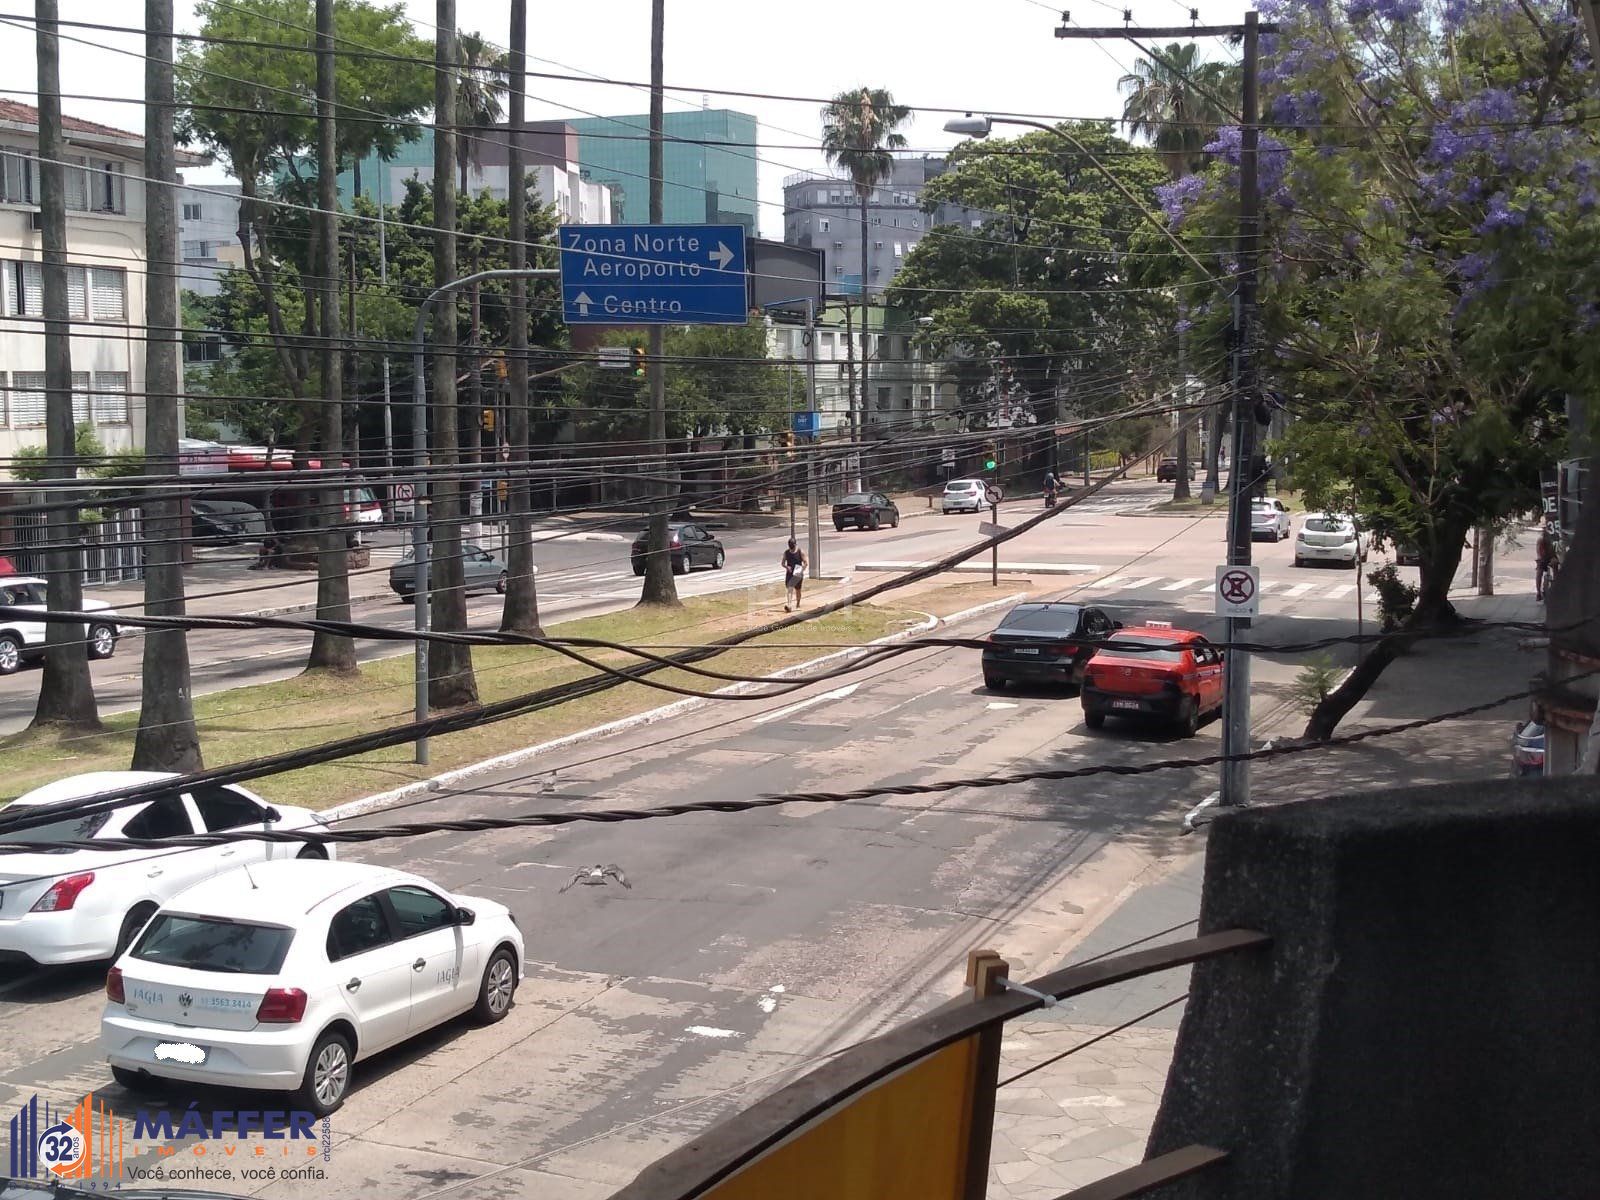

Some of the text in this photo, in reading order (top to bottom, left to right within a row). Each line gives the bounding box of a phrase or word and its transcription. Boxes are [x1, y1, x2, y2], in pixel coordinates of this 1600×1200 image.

[567, 233, 701, 253] Zona Norte
[583, 257, 702, 280] Aeroporto
[603, 294, 683, 314] Centro
